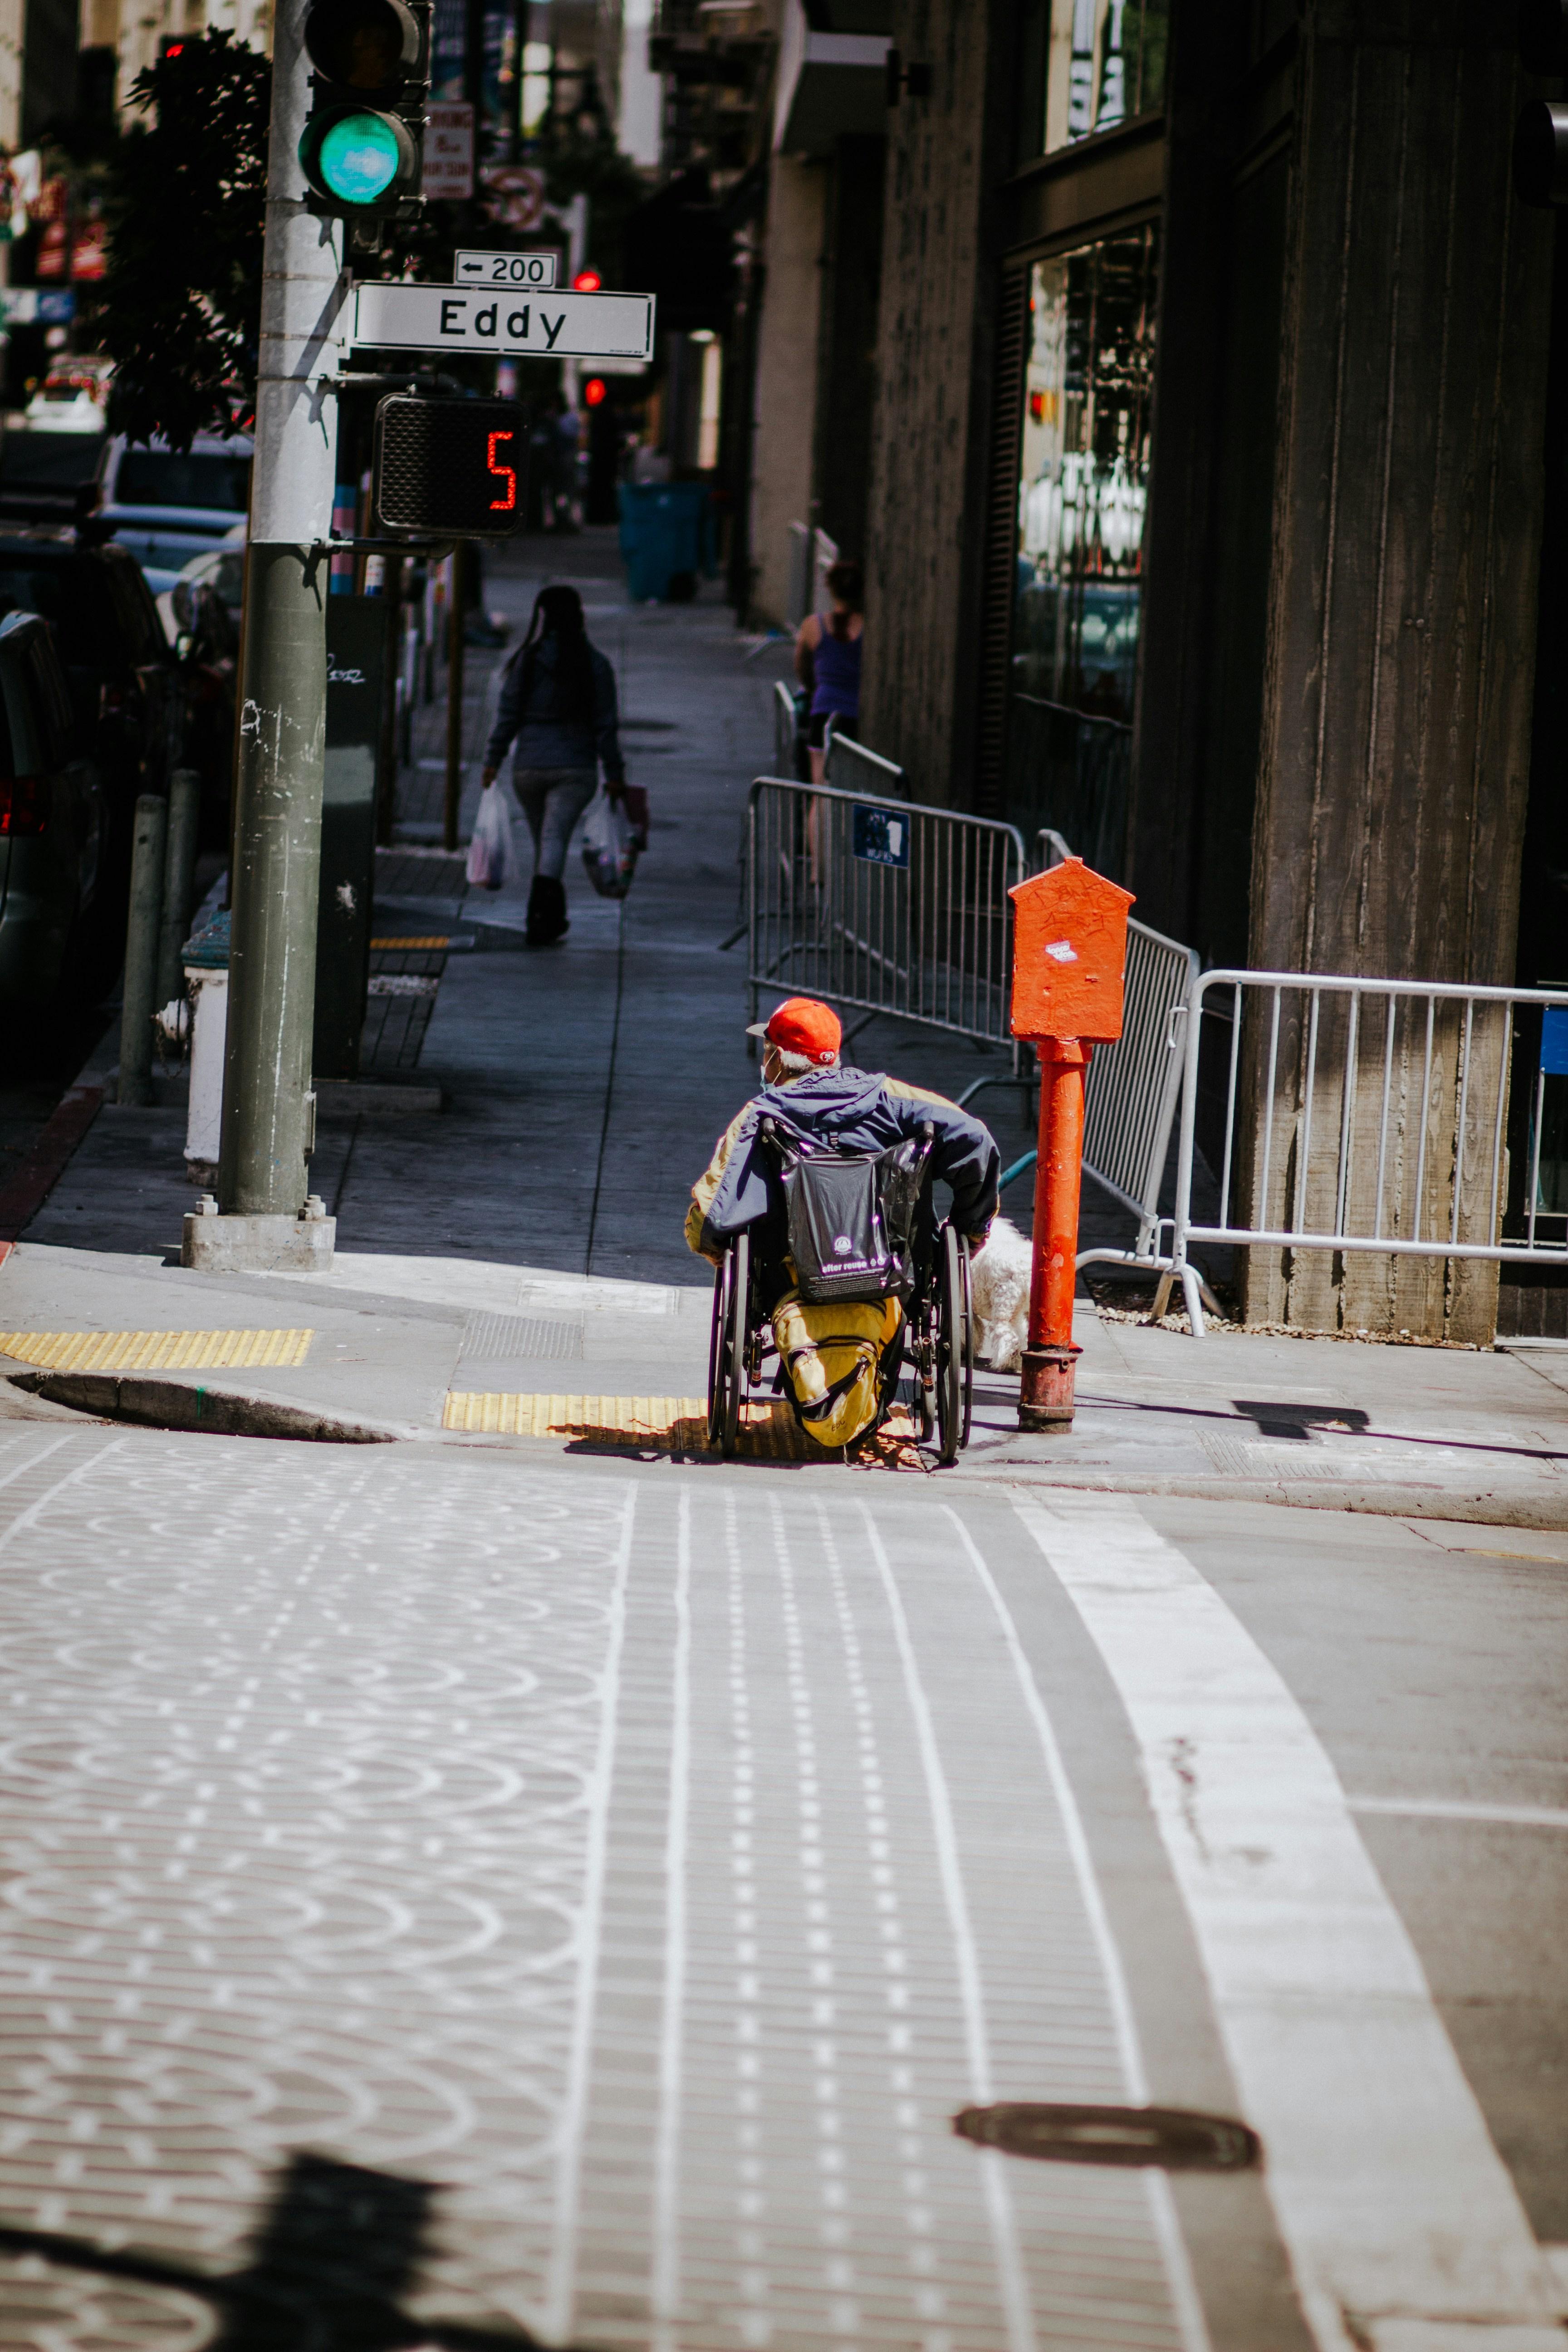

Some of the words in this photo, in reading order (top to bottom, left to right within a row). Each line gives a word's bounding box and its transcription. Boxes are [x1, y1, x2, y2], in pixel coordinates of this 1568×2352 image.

[492, 258, 544, 282] 200
[440, 299, 566, 349] Eddy
[487, 431, 516, 510] 5
[822, 1264, 843, 1273] after
[843, 1261, 867, 1270] reuse
